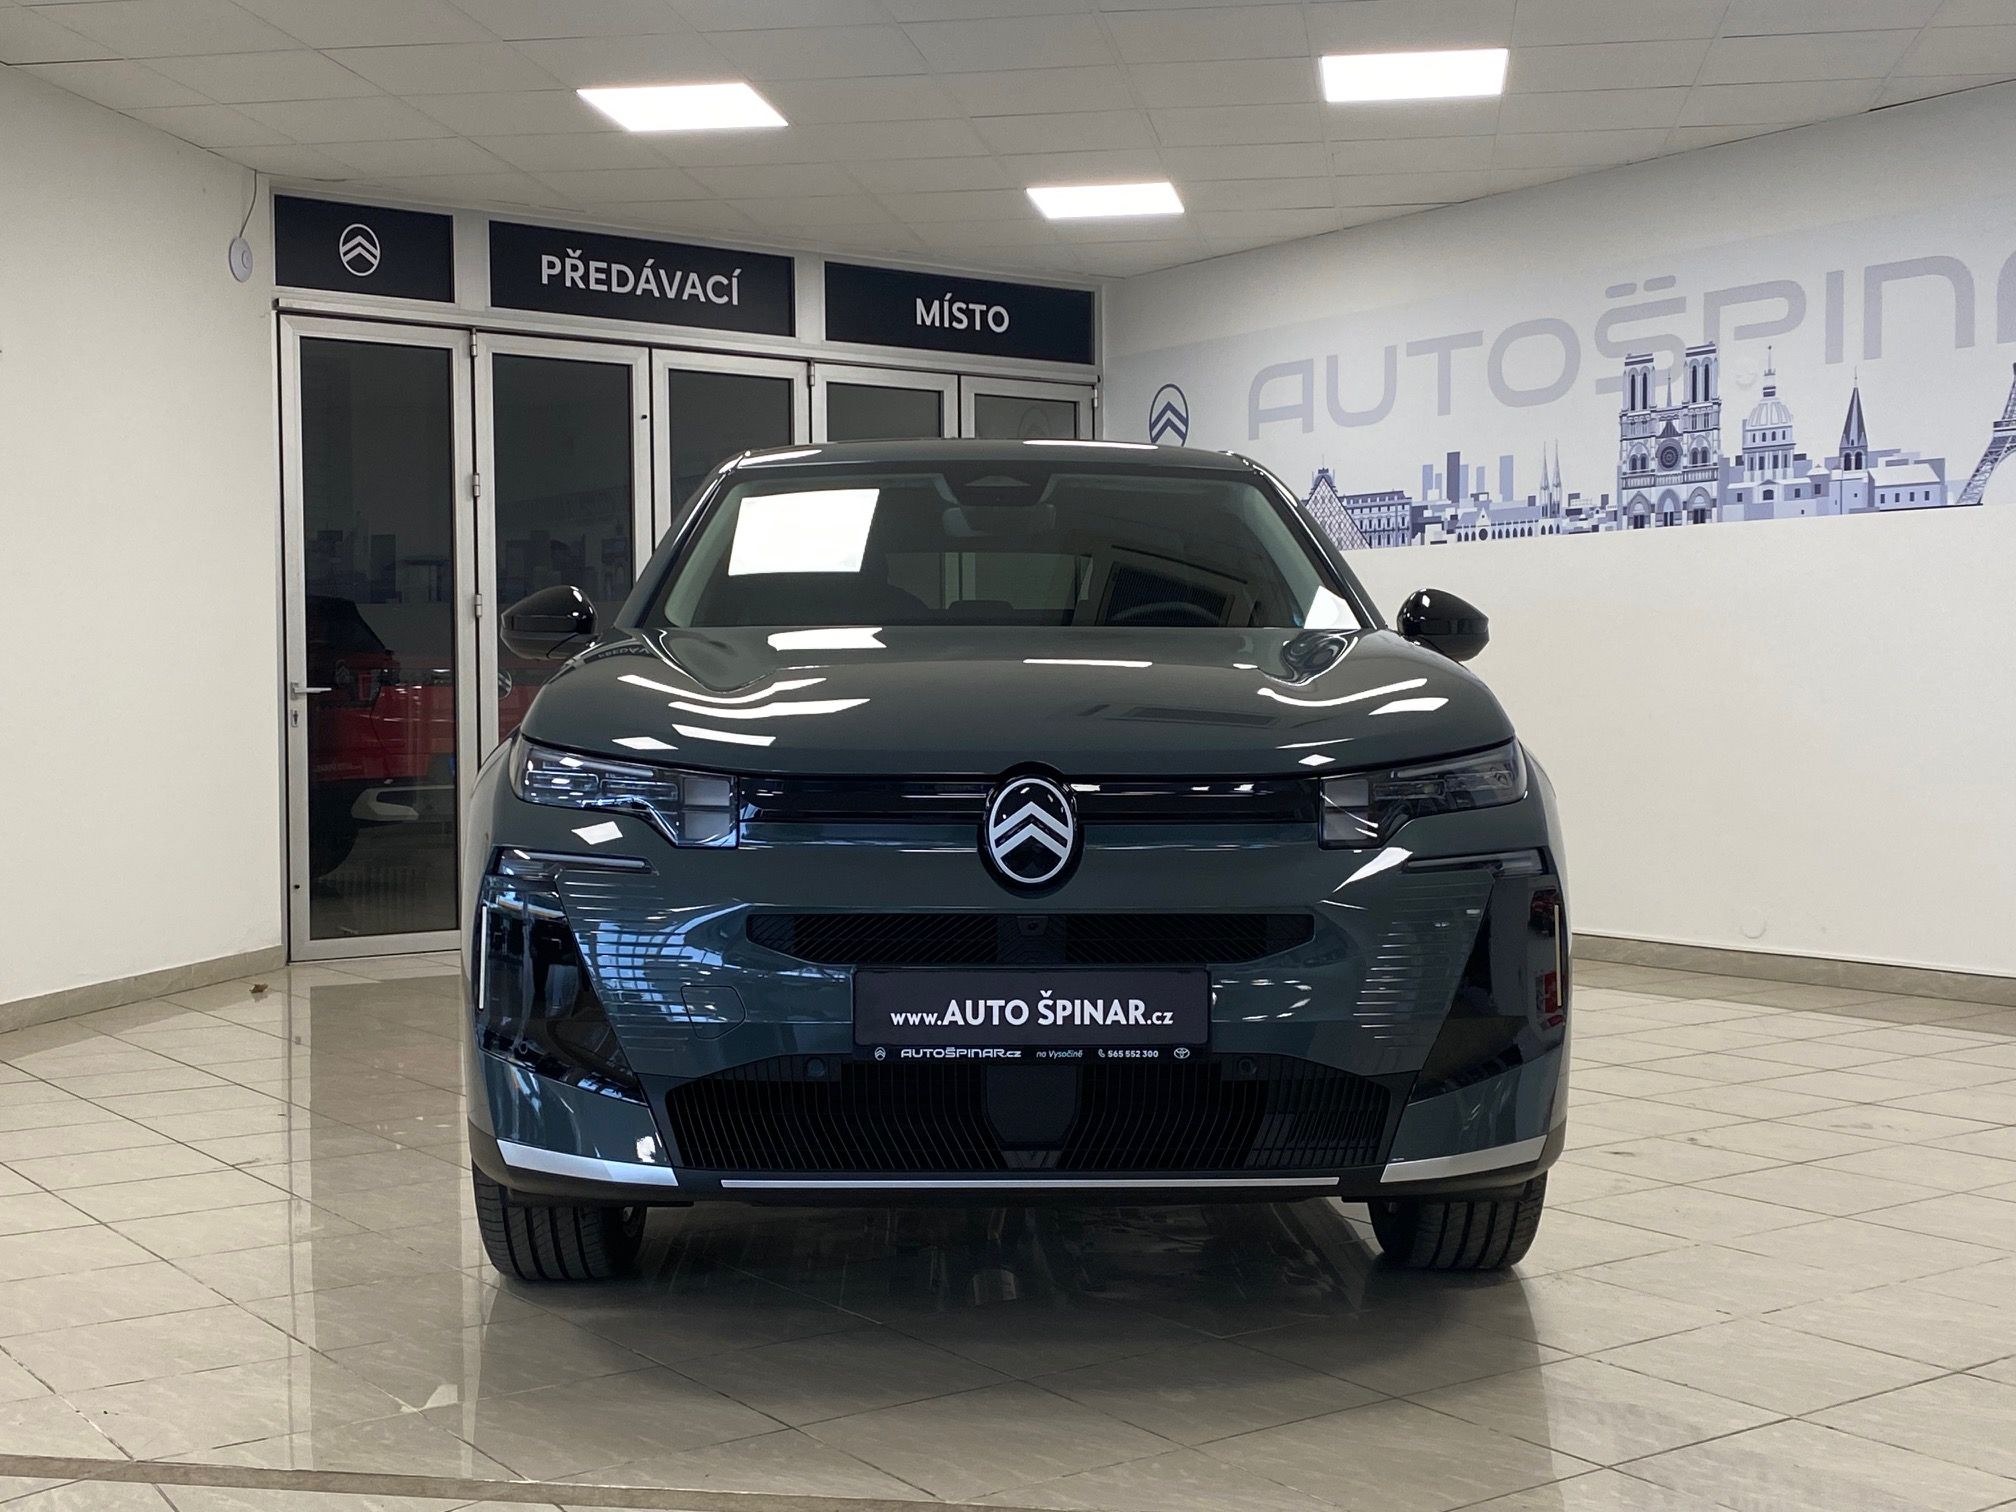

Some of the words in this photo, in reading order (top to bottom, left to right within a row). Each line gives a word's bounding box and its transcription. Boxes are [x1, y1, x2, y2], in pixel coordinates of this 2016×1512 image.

[540, 248, 741, 306] PŘEDÁVACÍ
[914, 292, 1011, 333] MÍSTO
[1247, 249, 2016, 441] AUTOŠPIN
[890, 998, 1030, 1026] www.AUTO
[1036, 989, 1175, 1026] ŠPINAR.cz
[1048, 1048, 1083, 1060] Vysočině
[1107, 1049, 1124, 1058] 565
[1125, 1049, 1141, 1058] 552
[1142, 1049, 1159, 1058] 300
